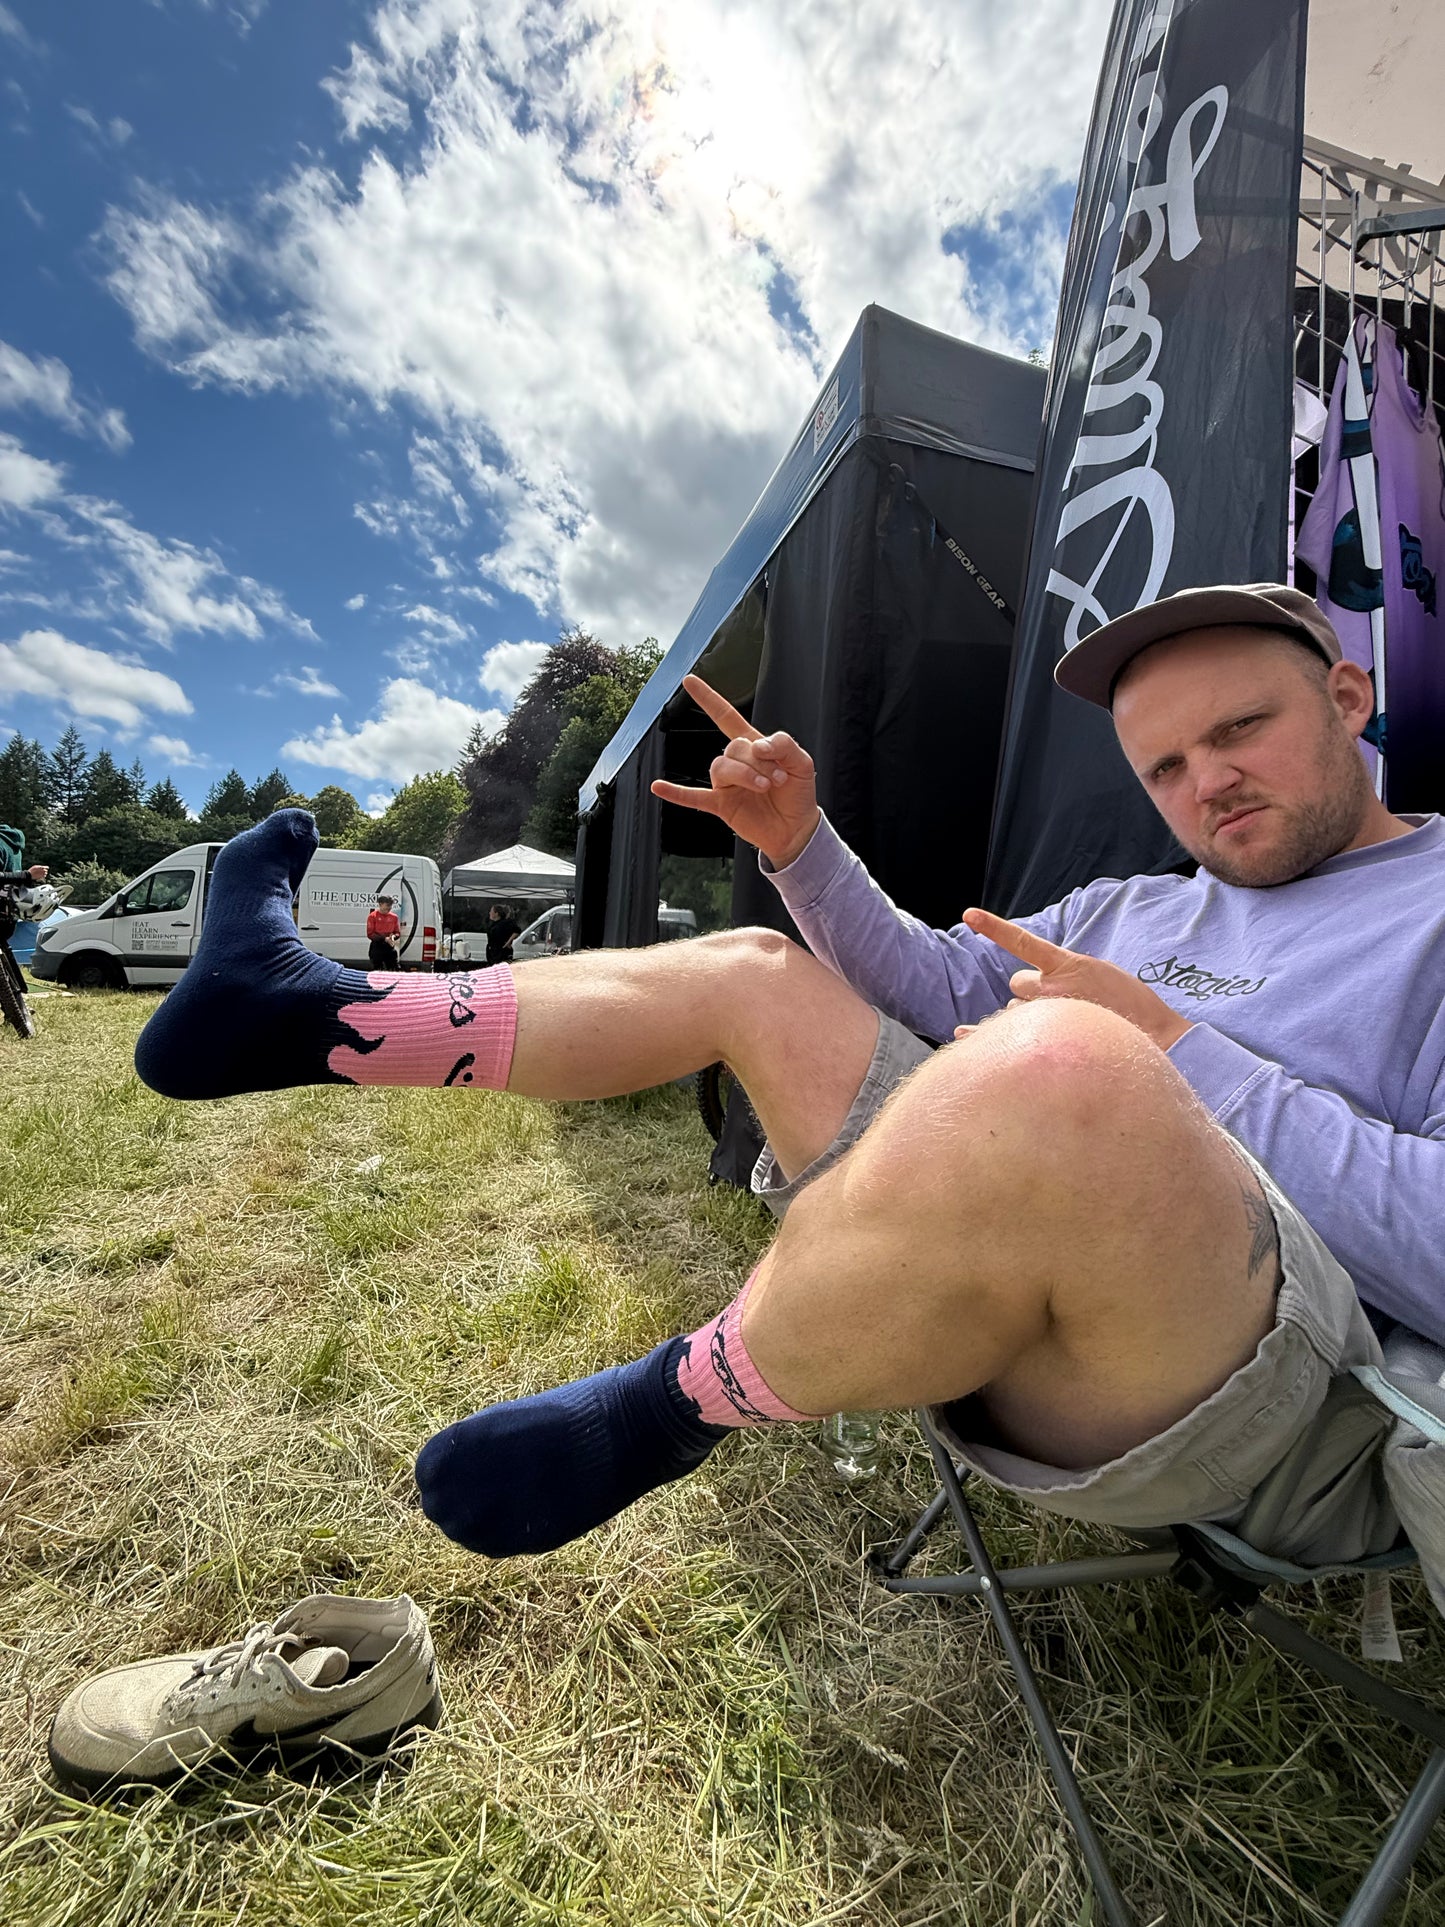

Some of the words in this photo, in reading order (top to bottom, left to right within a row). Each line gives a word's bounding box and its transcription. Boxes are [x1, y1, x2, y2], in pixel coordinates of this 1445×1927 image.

[945, 538, 978, 575] BISON
[976, 575, 1006, 609] GEAR
[311, 891, 339, 902] THE
[342, 892, 399, 903] TUSKS
[1137, 955, 1267, 1001] Stogies
